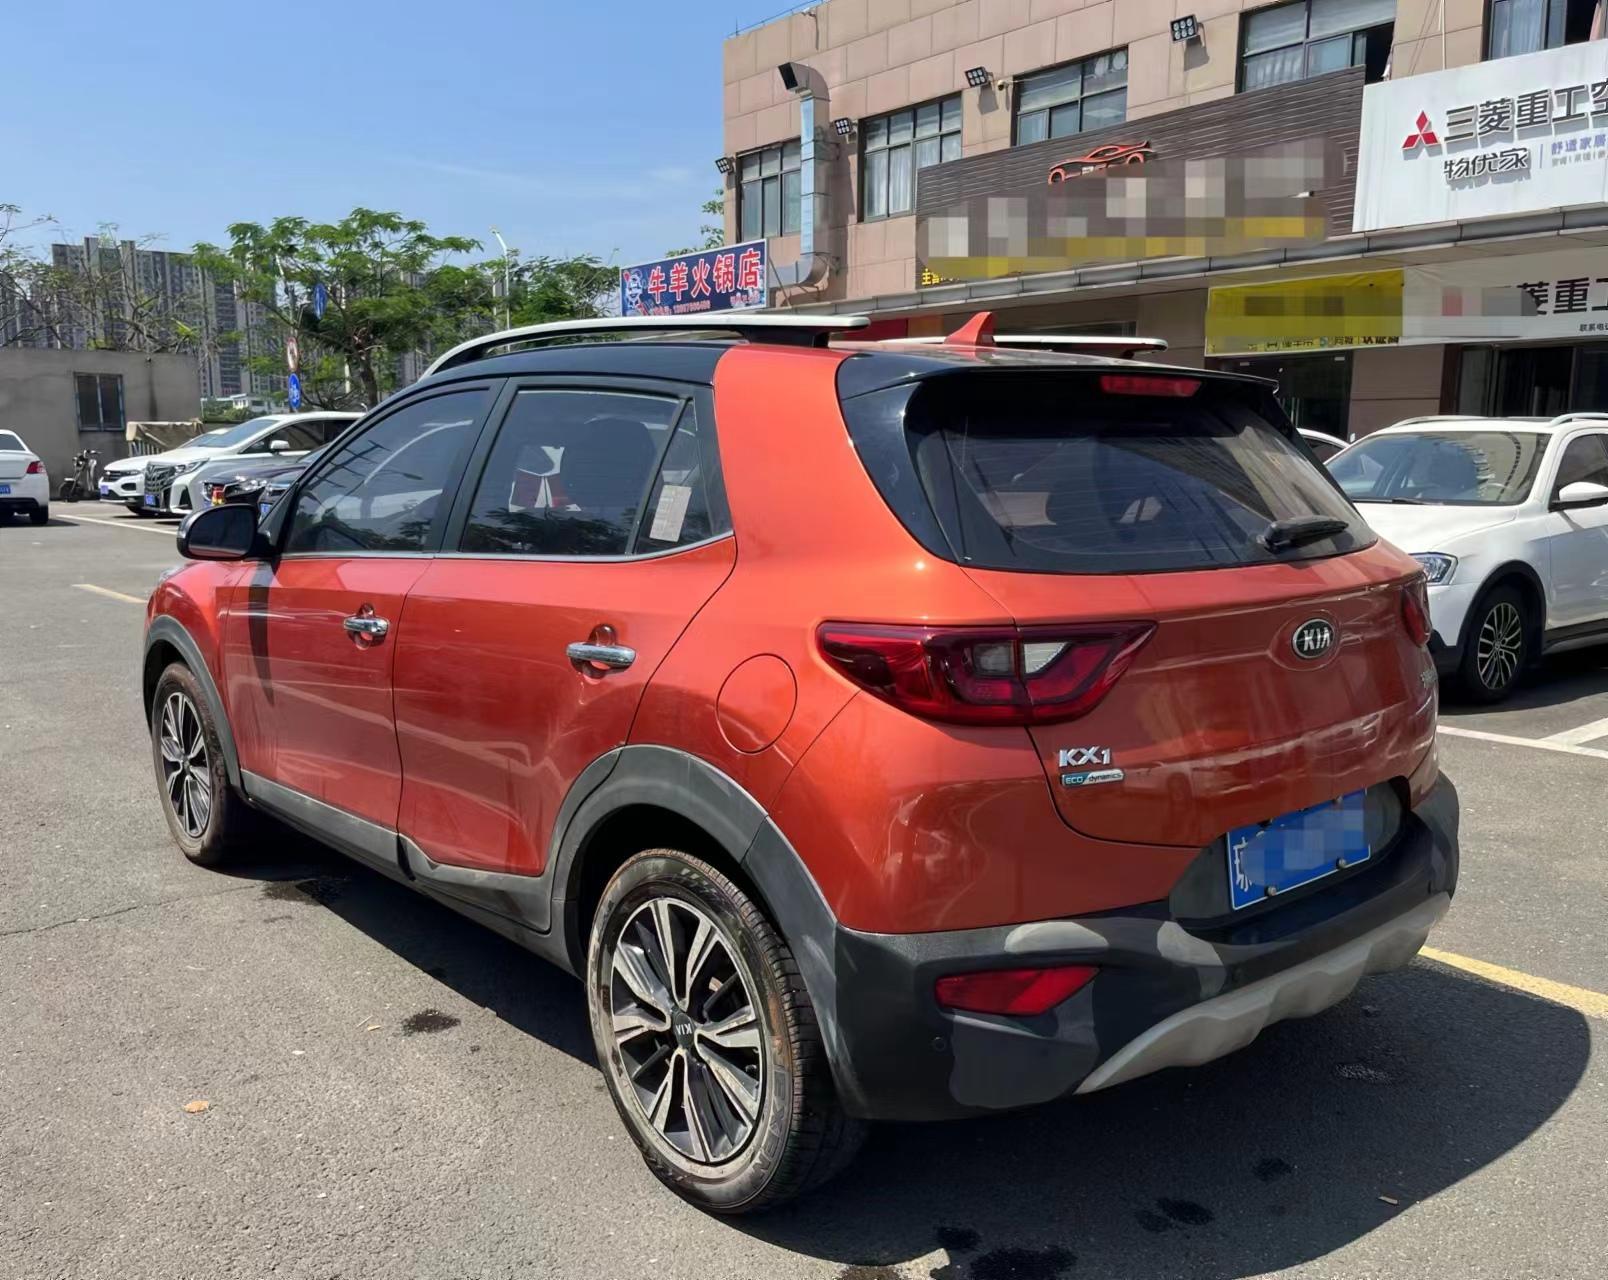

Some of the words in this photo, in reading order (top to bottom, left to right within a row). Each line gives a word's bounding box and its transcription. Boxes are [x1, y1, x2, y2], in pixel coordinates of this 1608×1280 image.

[1443, 147, 1528, 180] 物优家
[648, 248, 761, 304] 牛羊火锅店
[1303, 628, 1332, 652] KIA
[1058, 745, 1111, 767] KX1
[1088, 772, 1122, 783] dynamics
[675, 1023, 693, 1035] KIA
